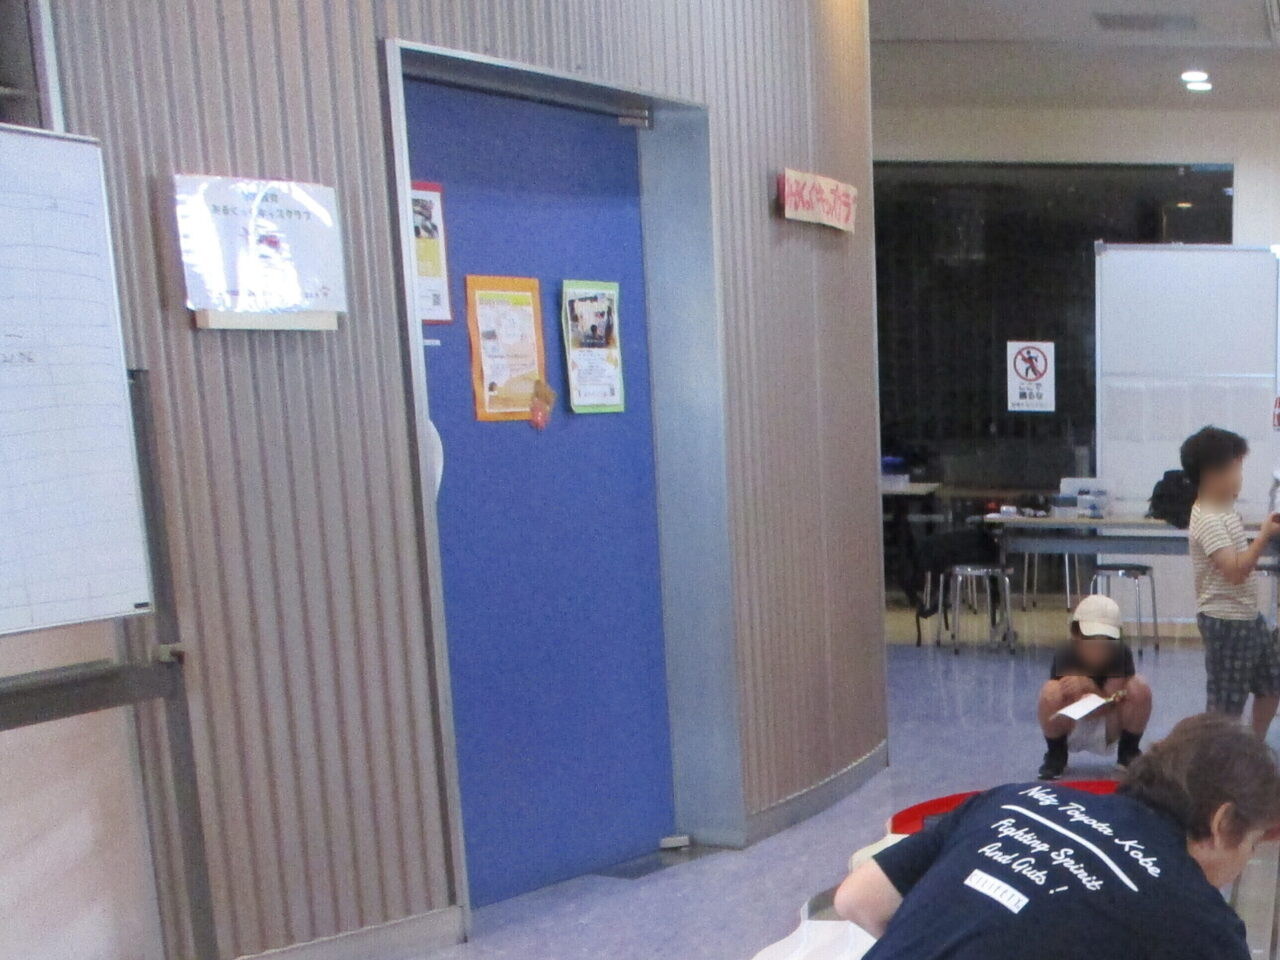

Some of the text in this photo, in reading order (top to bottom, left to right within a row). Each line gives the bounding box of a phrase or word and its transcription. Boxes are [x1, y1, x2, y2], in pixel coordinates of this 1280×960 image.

[978, 842, 1015, 865] And
[1012, 857, 1049, 885] Guts
[990, 818, 1050, 853] Fighting
[1050, 848, 1104, 891] Spirit
[1058, 802, 1114, 836] Toyota
[1114, 838, 1161, 878] Kobe
